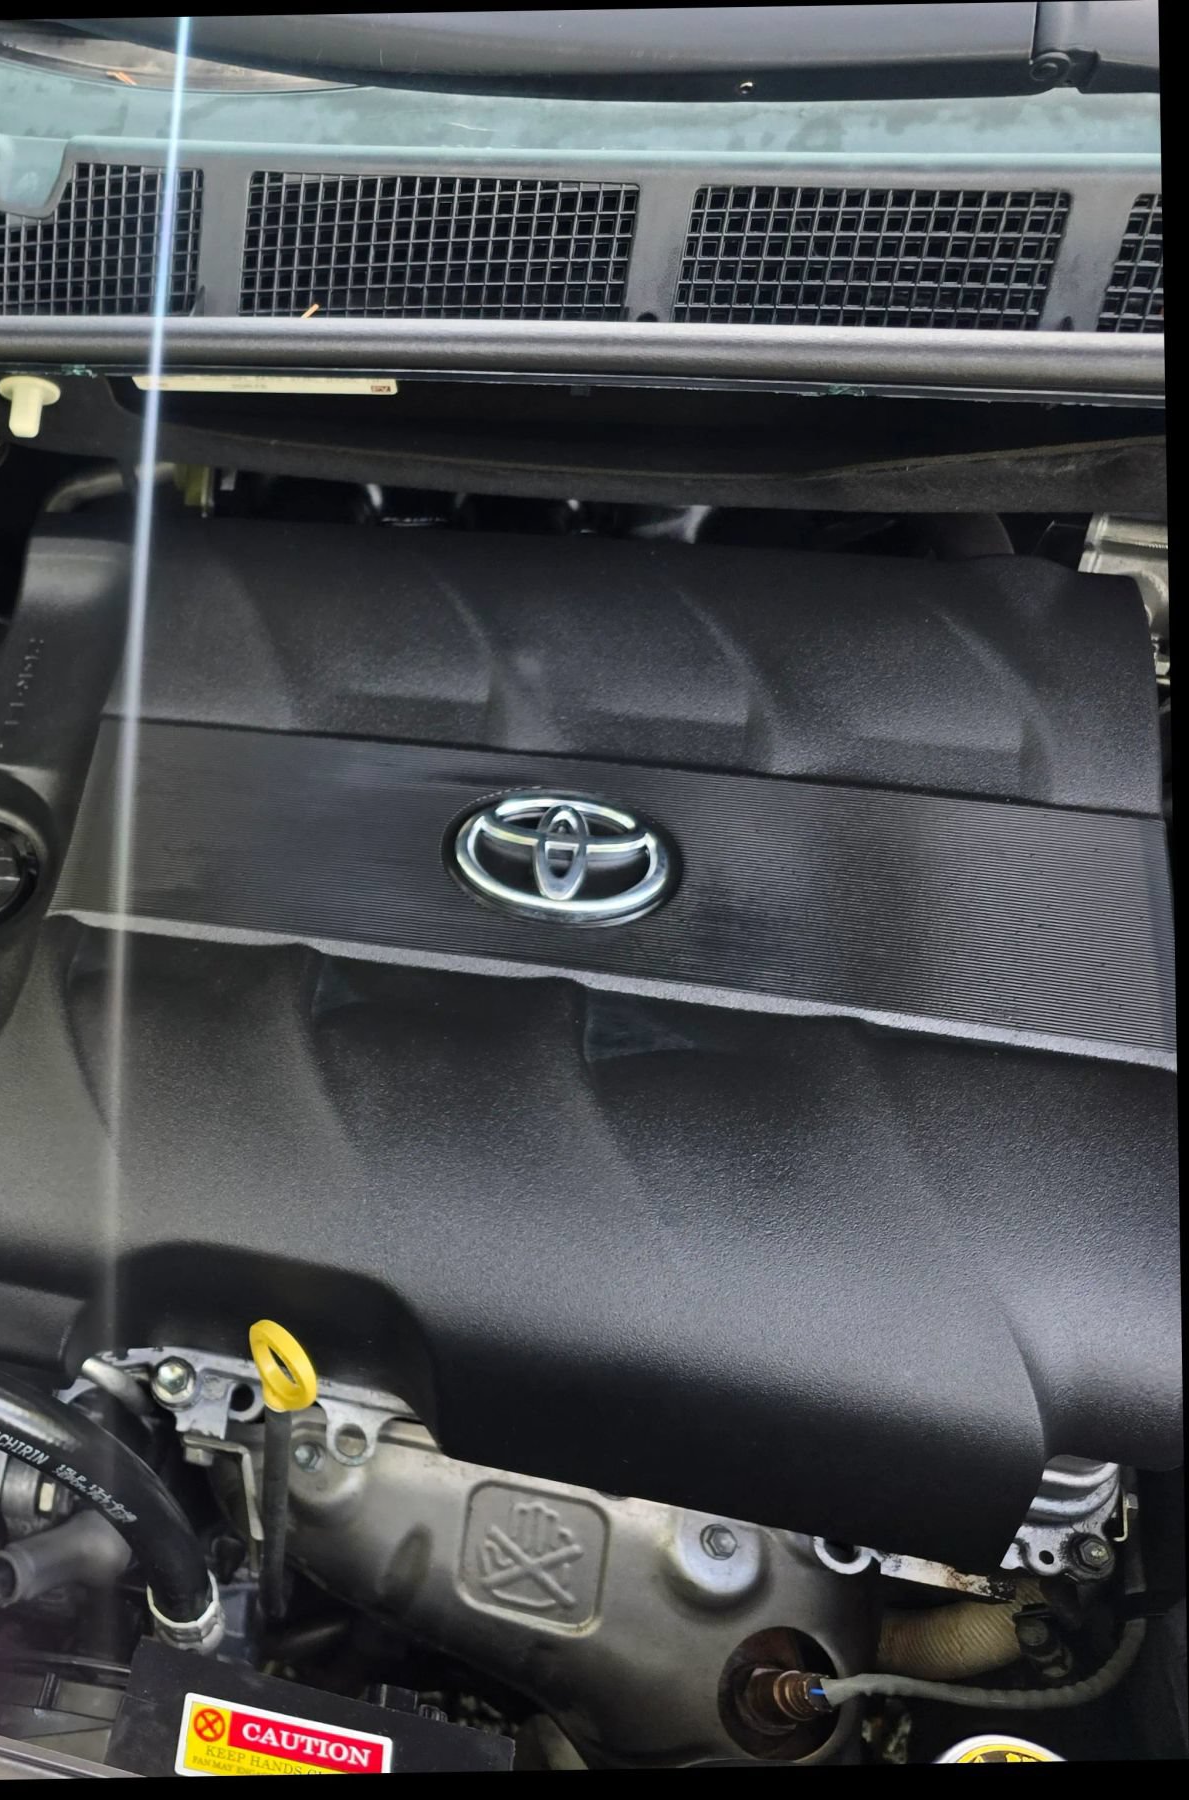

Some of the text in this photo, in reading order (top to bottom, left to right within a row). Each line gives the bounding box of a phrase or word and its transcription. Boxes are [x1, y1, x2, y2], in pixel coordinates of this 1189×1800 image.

[205, 1745, 246, 1763] KEEP
[250, 1755, 302, 1775] HANDS
[242, 1722, 372, 1767] CAUTION
